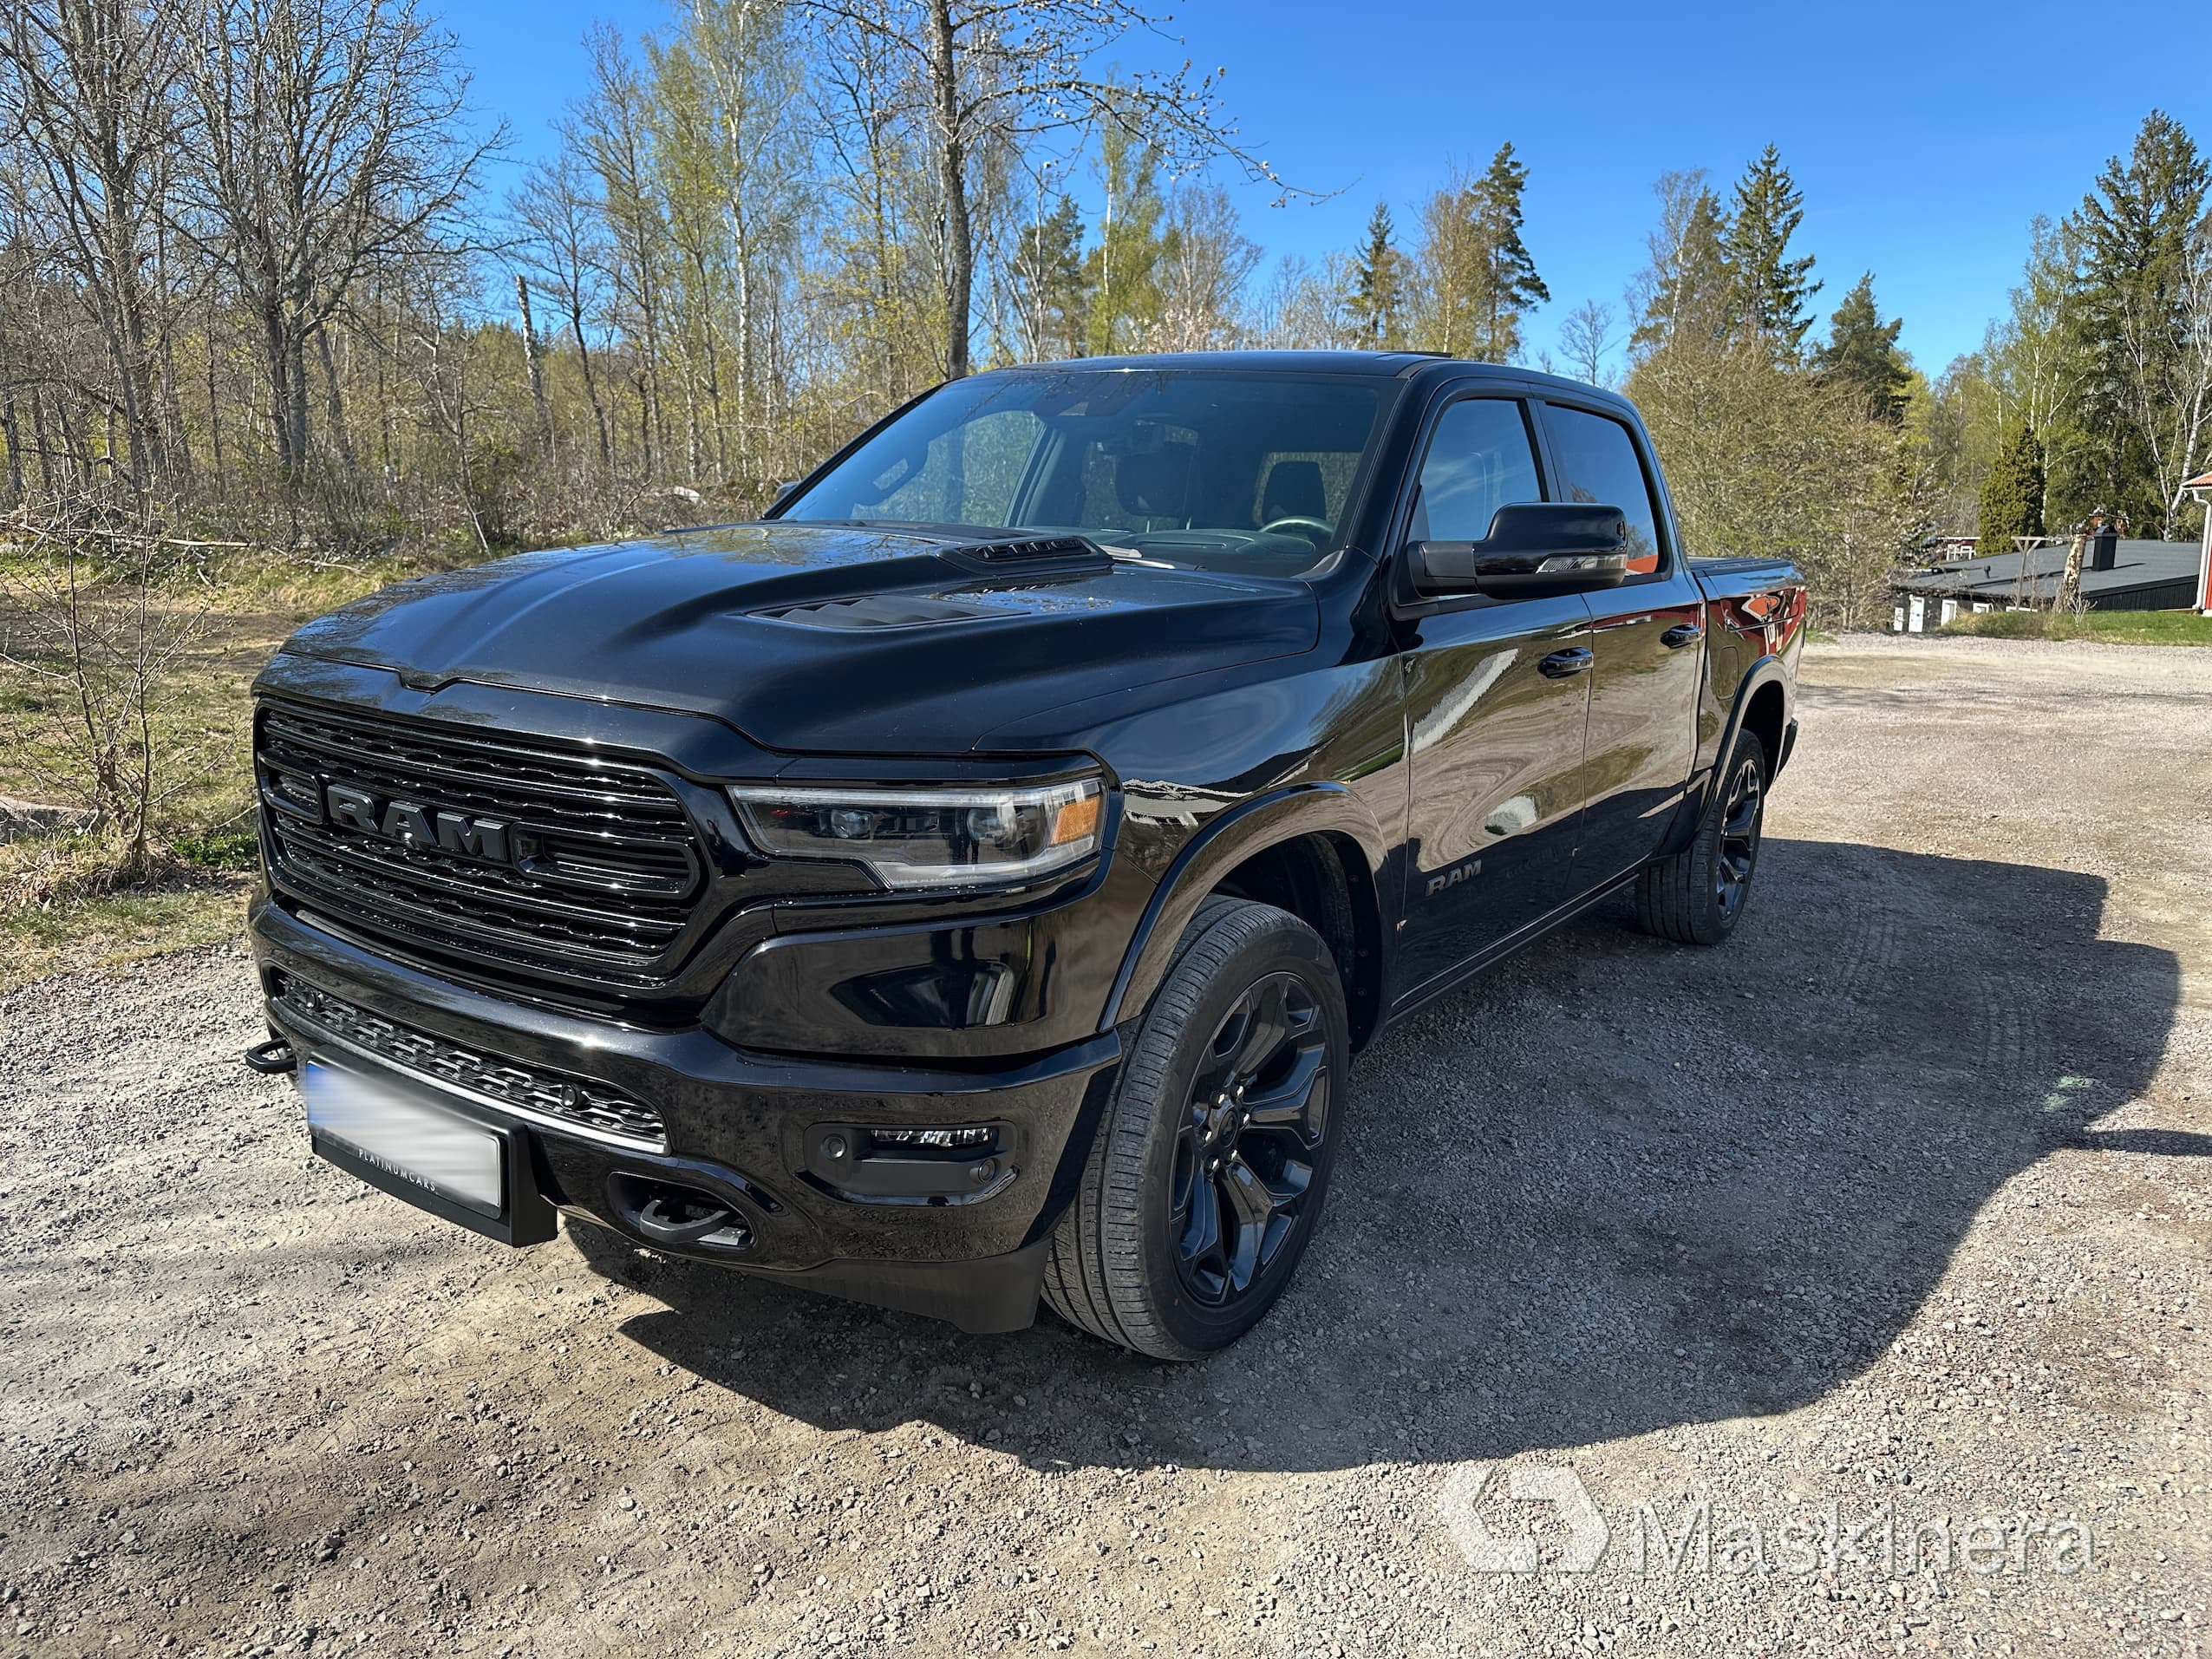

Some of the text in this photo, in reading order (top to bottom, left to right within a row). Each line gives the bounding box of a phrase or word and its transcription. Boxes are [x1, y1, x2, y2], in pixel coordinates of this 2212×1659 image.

[327, 784, 507, 862] RAM
[1426, 859, 1482, 897] RAM
[358, 1148, 435, 1192] PLATINUMCARS
